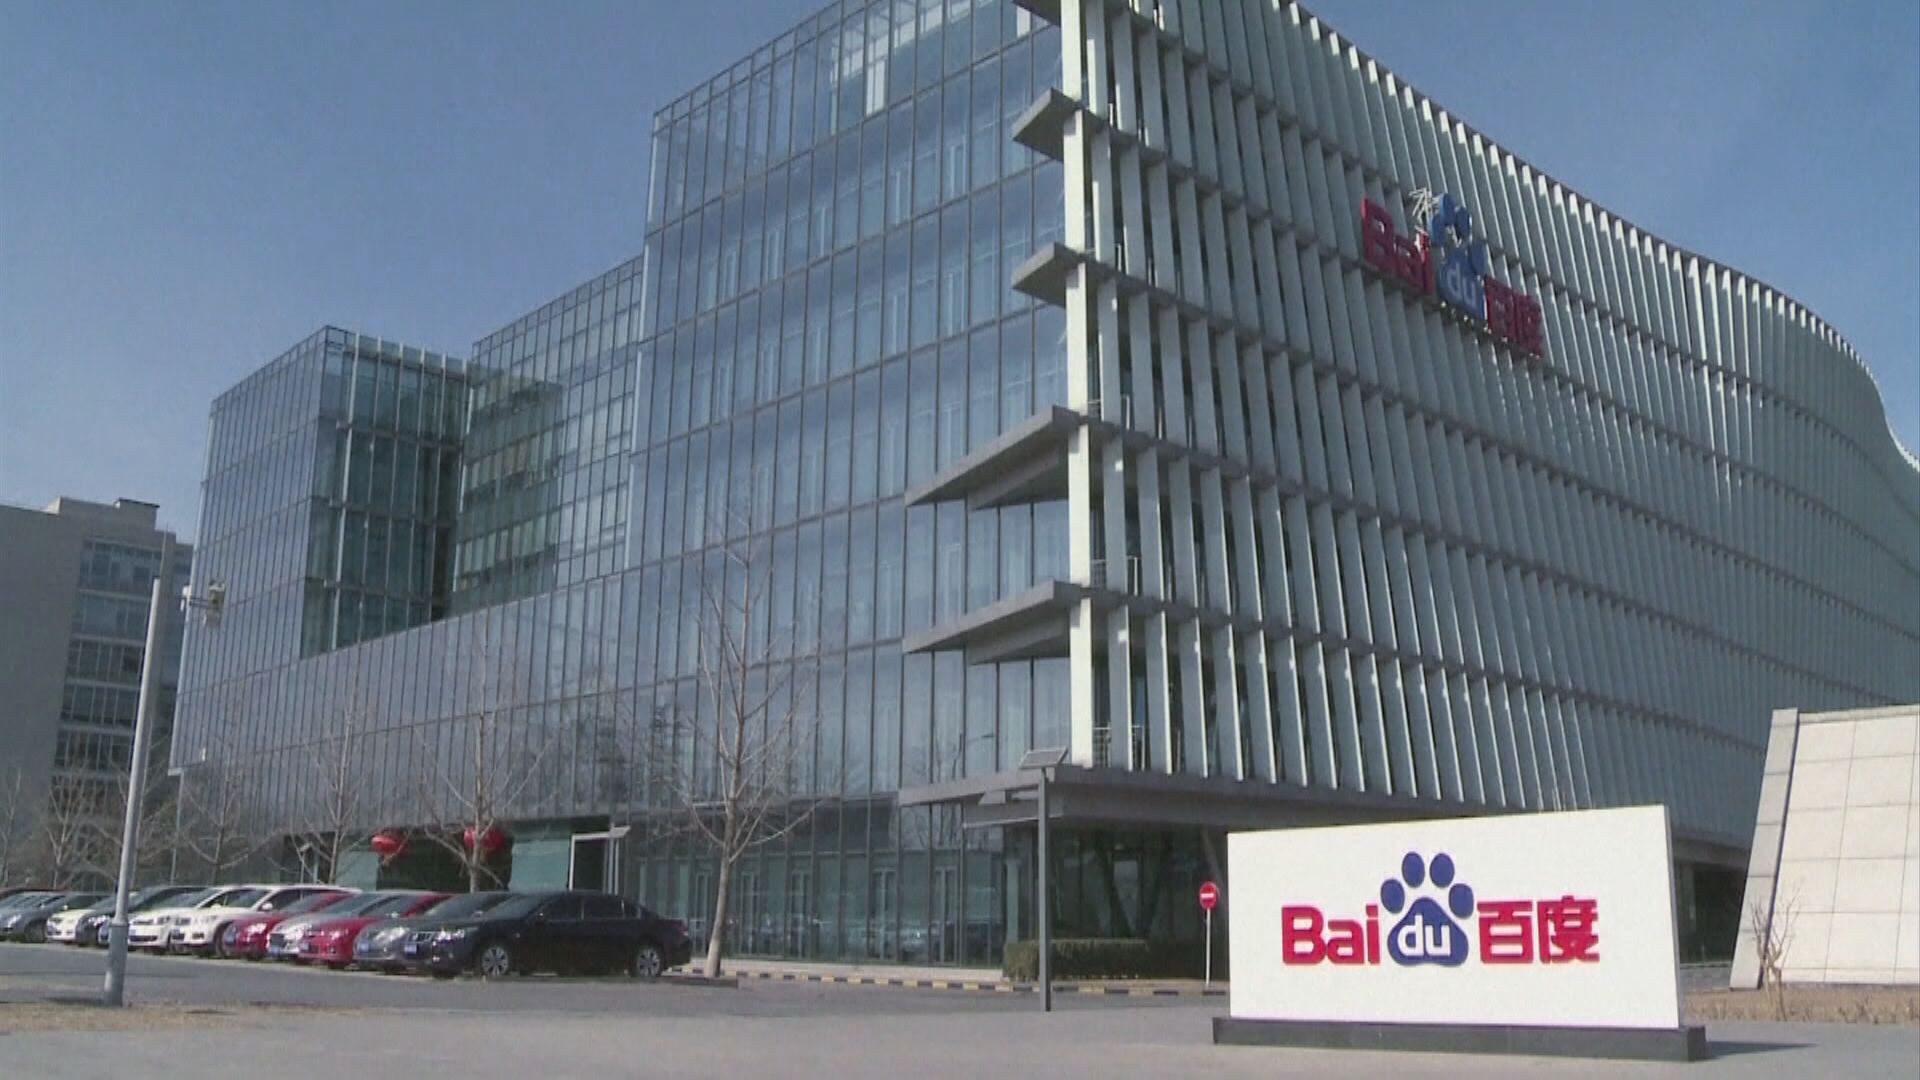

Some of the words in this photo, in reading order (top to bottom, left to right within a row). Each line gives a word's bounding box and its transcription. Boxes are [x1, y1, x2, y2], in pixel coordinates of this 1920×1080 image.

[1361, 196, 1433, 296] Bai
[1448, 261, 1477, 309] du
[1281, 904, 1380, 965] Bai
[1398, 914, 1451, 956] du
[1477, 895, 1600, 964] 百度
